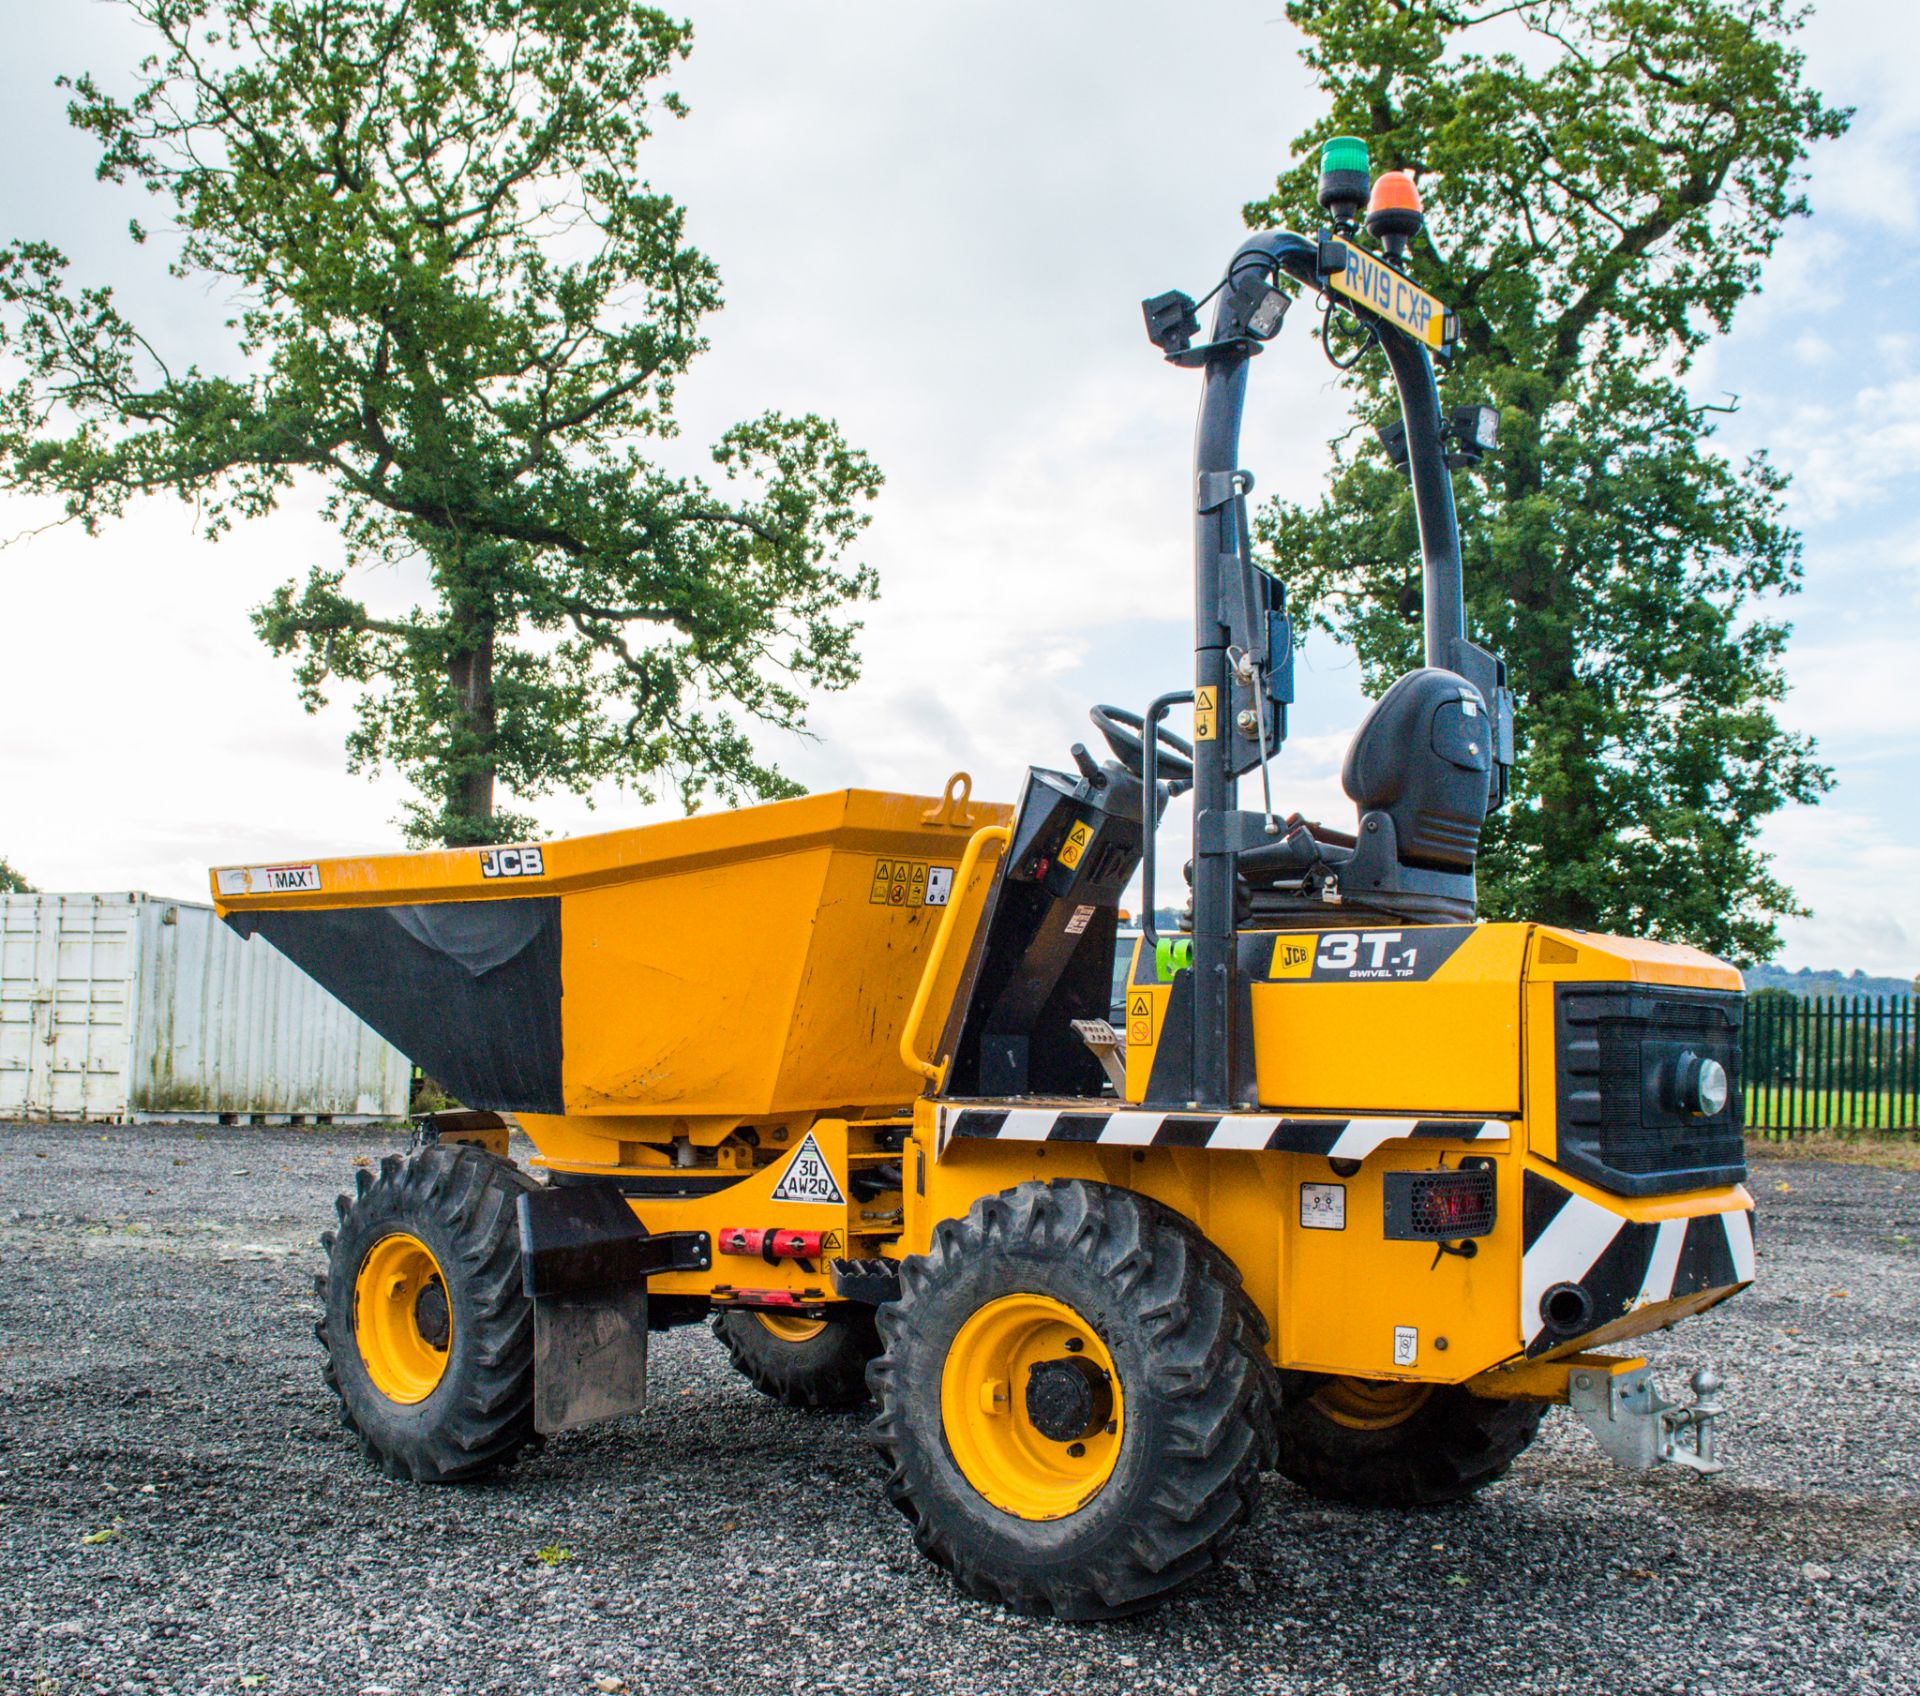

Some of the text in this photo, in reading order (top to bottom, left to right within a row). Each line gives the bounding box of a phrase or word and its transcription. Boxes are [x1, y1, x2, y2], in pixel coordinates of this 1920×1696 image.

[1345, 248, 1432, 332] RV19 CXP
[482, 848, 543, 877] JCB
[274, 871, 307, 888] MAX
[1283, 946, 1307, 966] JCB
[1348, 969, 1415, 978] SWIVEL TIP
[788, 1177, 829, 1196] AW2Q
